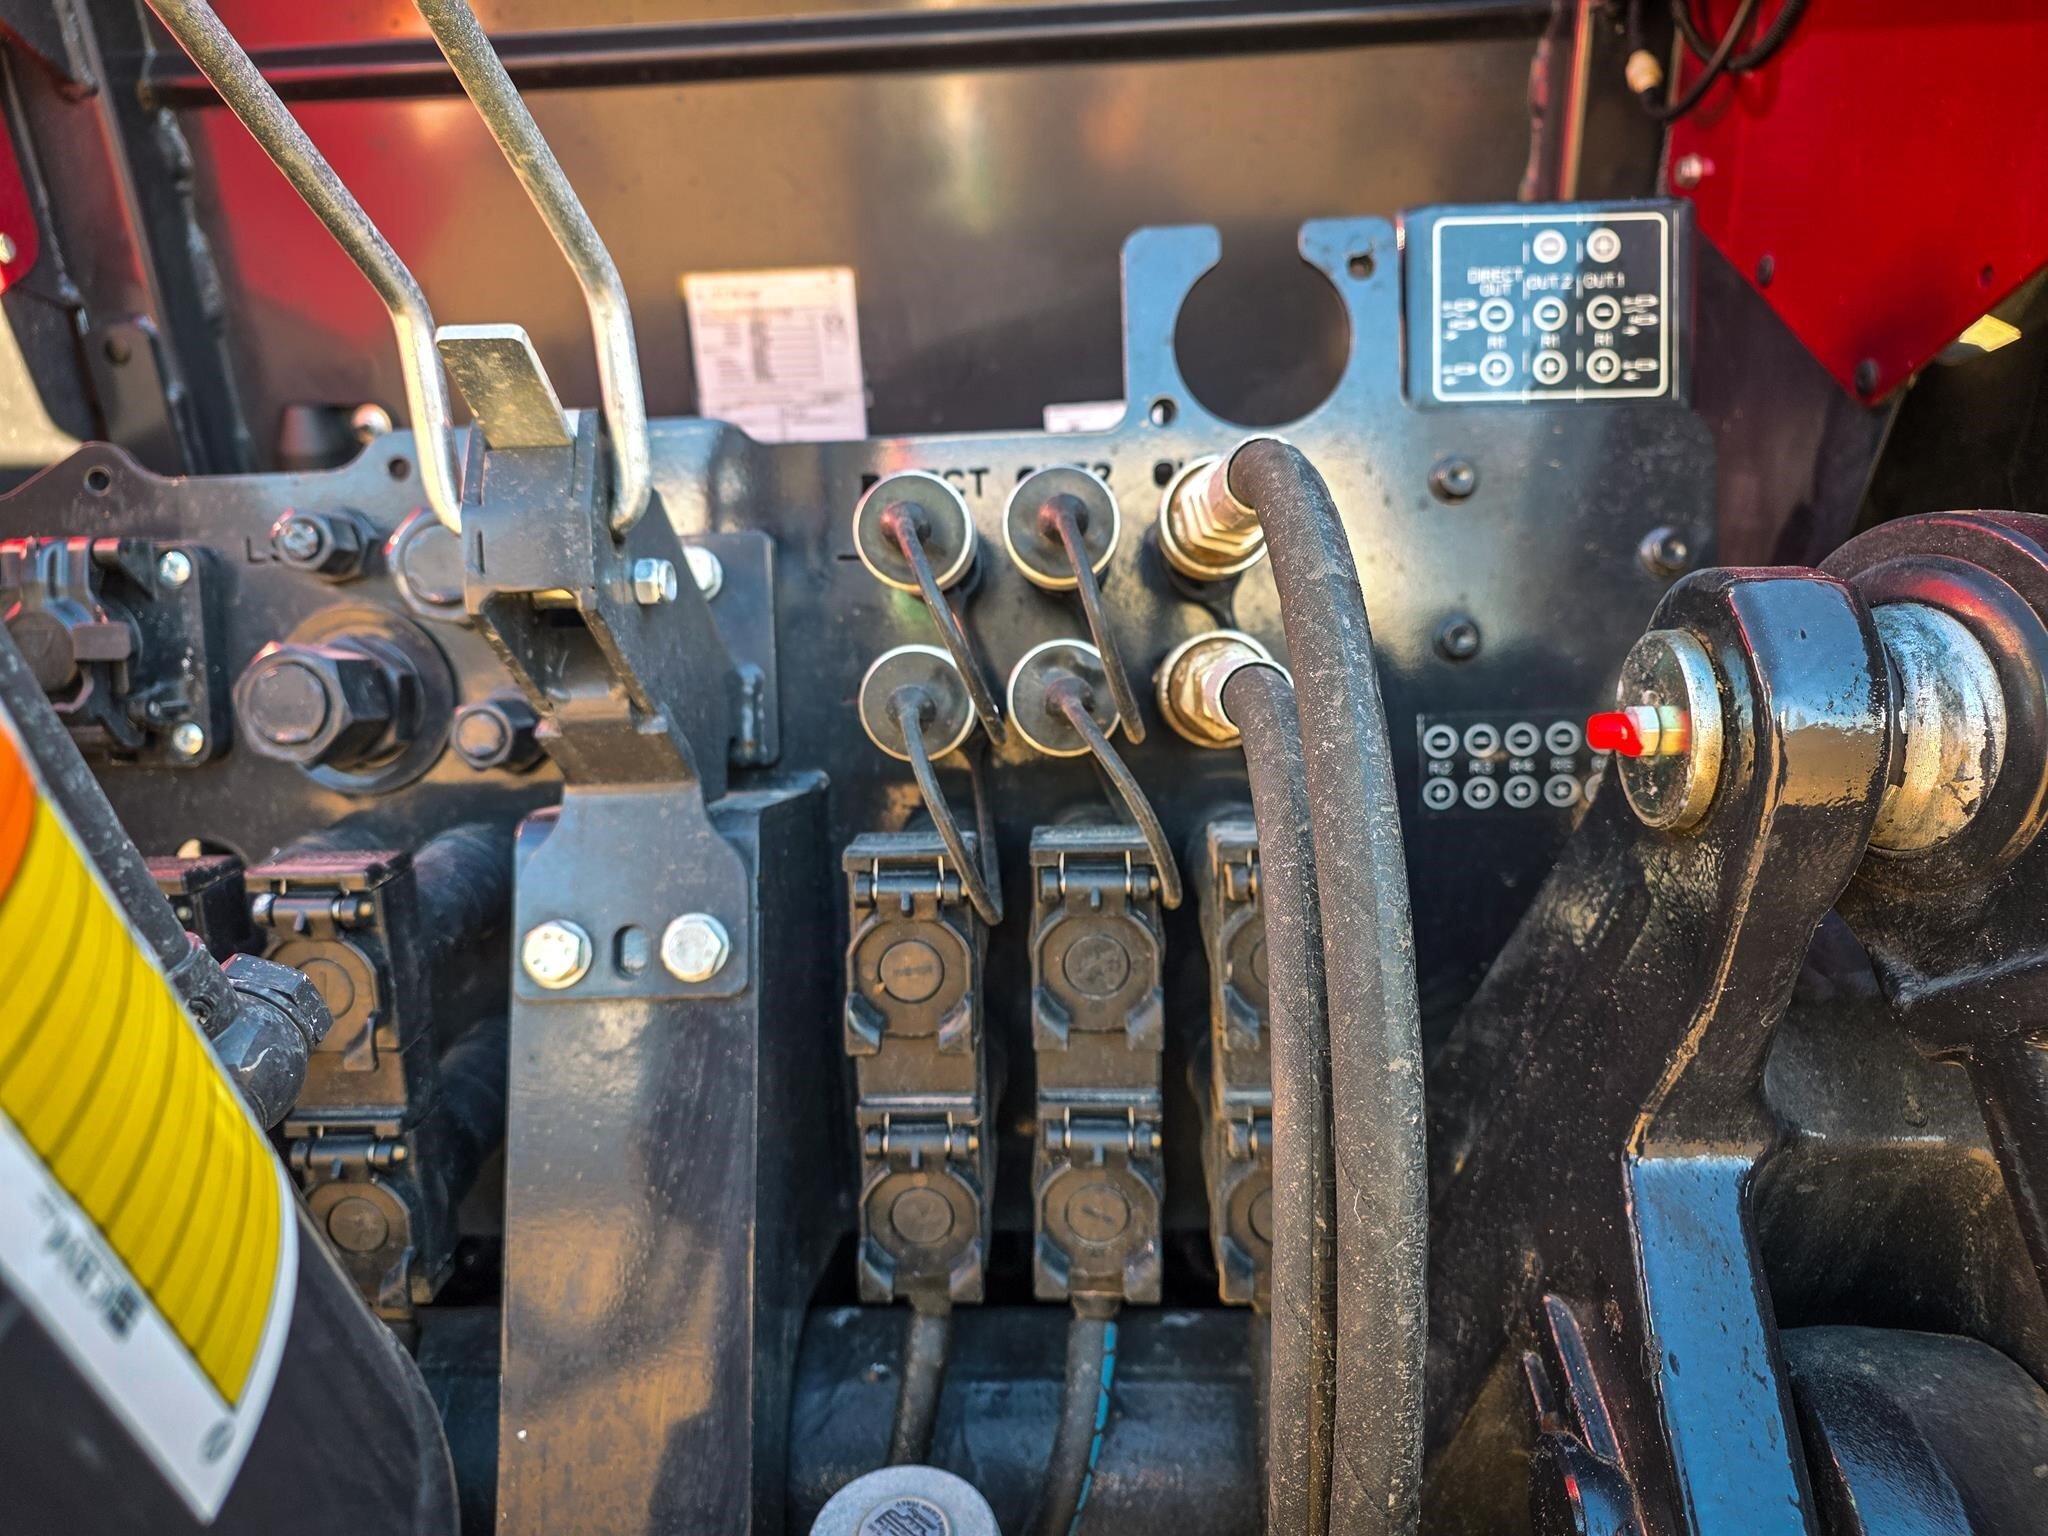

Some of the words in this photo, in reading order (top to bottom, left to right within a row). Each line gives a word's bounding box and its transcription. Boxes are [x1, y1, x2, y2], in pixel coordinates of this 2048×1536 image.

[1467, 266, 1524, 284] DIRECT
[1526, 273, 1558, 290] OUT
[1582, 272, 1615, 290] OUT
[1479, 283, 1512, 298] OUT
